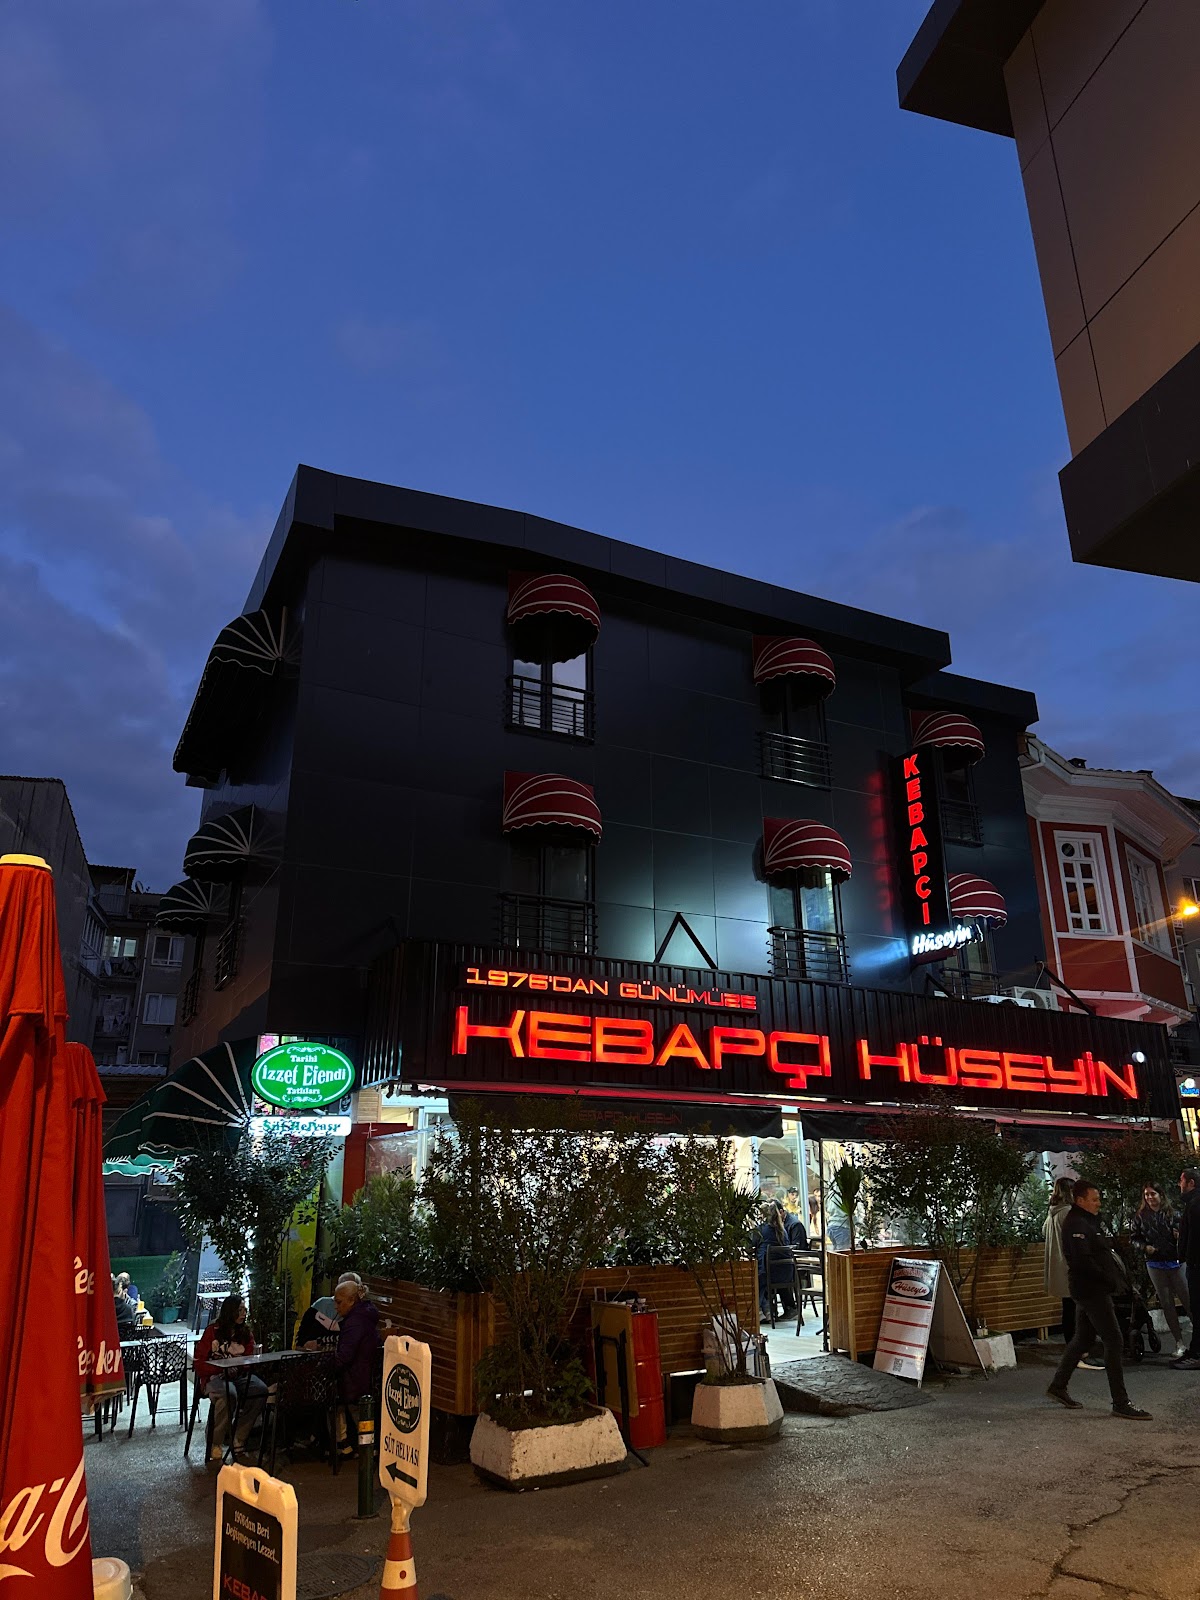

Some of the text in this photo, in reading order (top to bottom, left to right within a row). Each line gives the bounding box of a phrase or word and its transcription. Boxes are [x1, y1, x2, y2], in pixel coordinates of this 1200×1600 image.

[912, 924, 972, 955] Hüseyin
[466, 967, 757, 1010] 1976'DAN GÜNÜMÜZE
[290, 1055, 318, 1063] Tarihi
[452, 1005, 1139, 1100] KEBAPÇI HÜSEYİN
[262, 1065, 346, 1086] İzzet Efendi
[895, 1281, 927, 1296] Hüseyin
[256, 1521, 270, 1540] Beri
